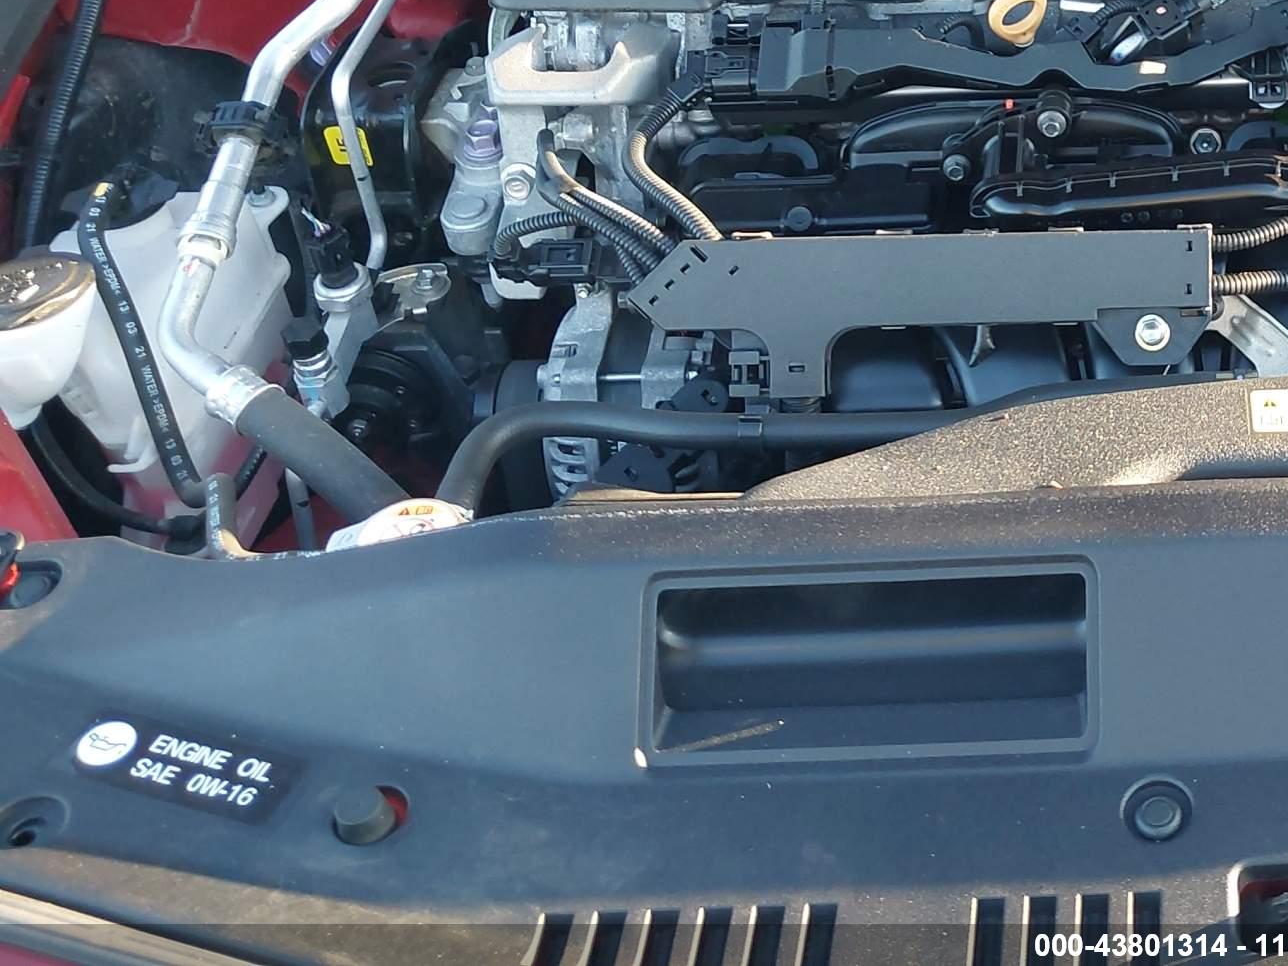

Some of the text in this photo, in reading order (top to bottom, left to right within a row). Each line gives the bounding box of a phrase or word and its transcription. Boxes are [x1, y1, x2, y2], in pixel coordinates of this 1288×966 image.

[89, 236, 108, 263] WATER
[125, 321, 138, 334] 03
[135, 345, 147, 358] 21
[141, 364, 159, 399] WATER
[130, 758, 258, 806] SAE 0W-16
[148, 734, 272, 782] ENGINE OIL
